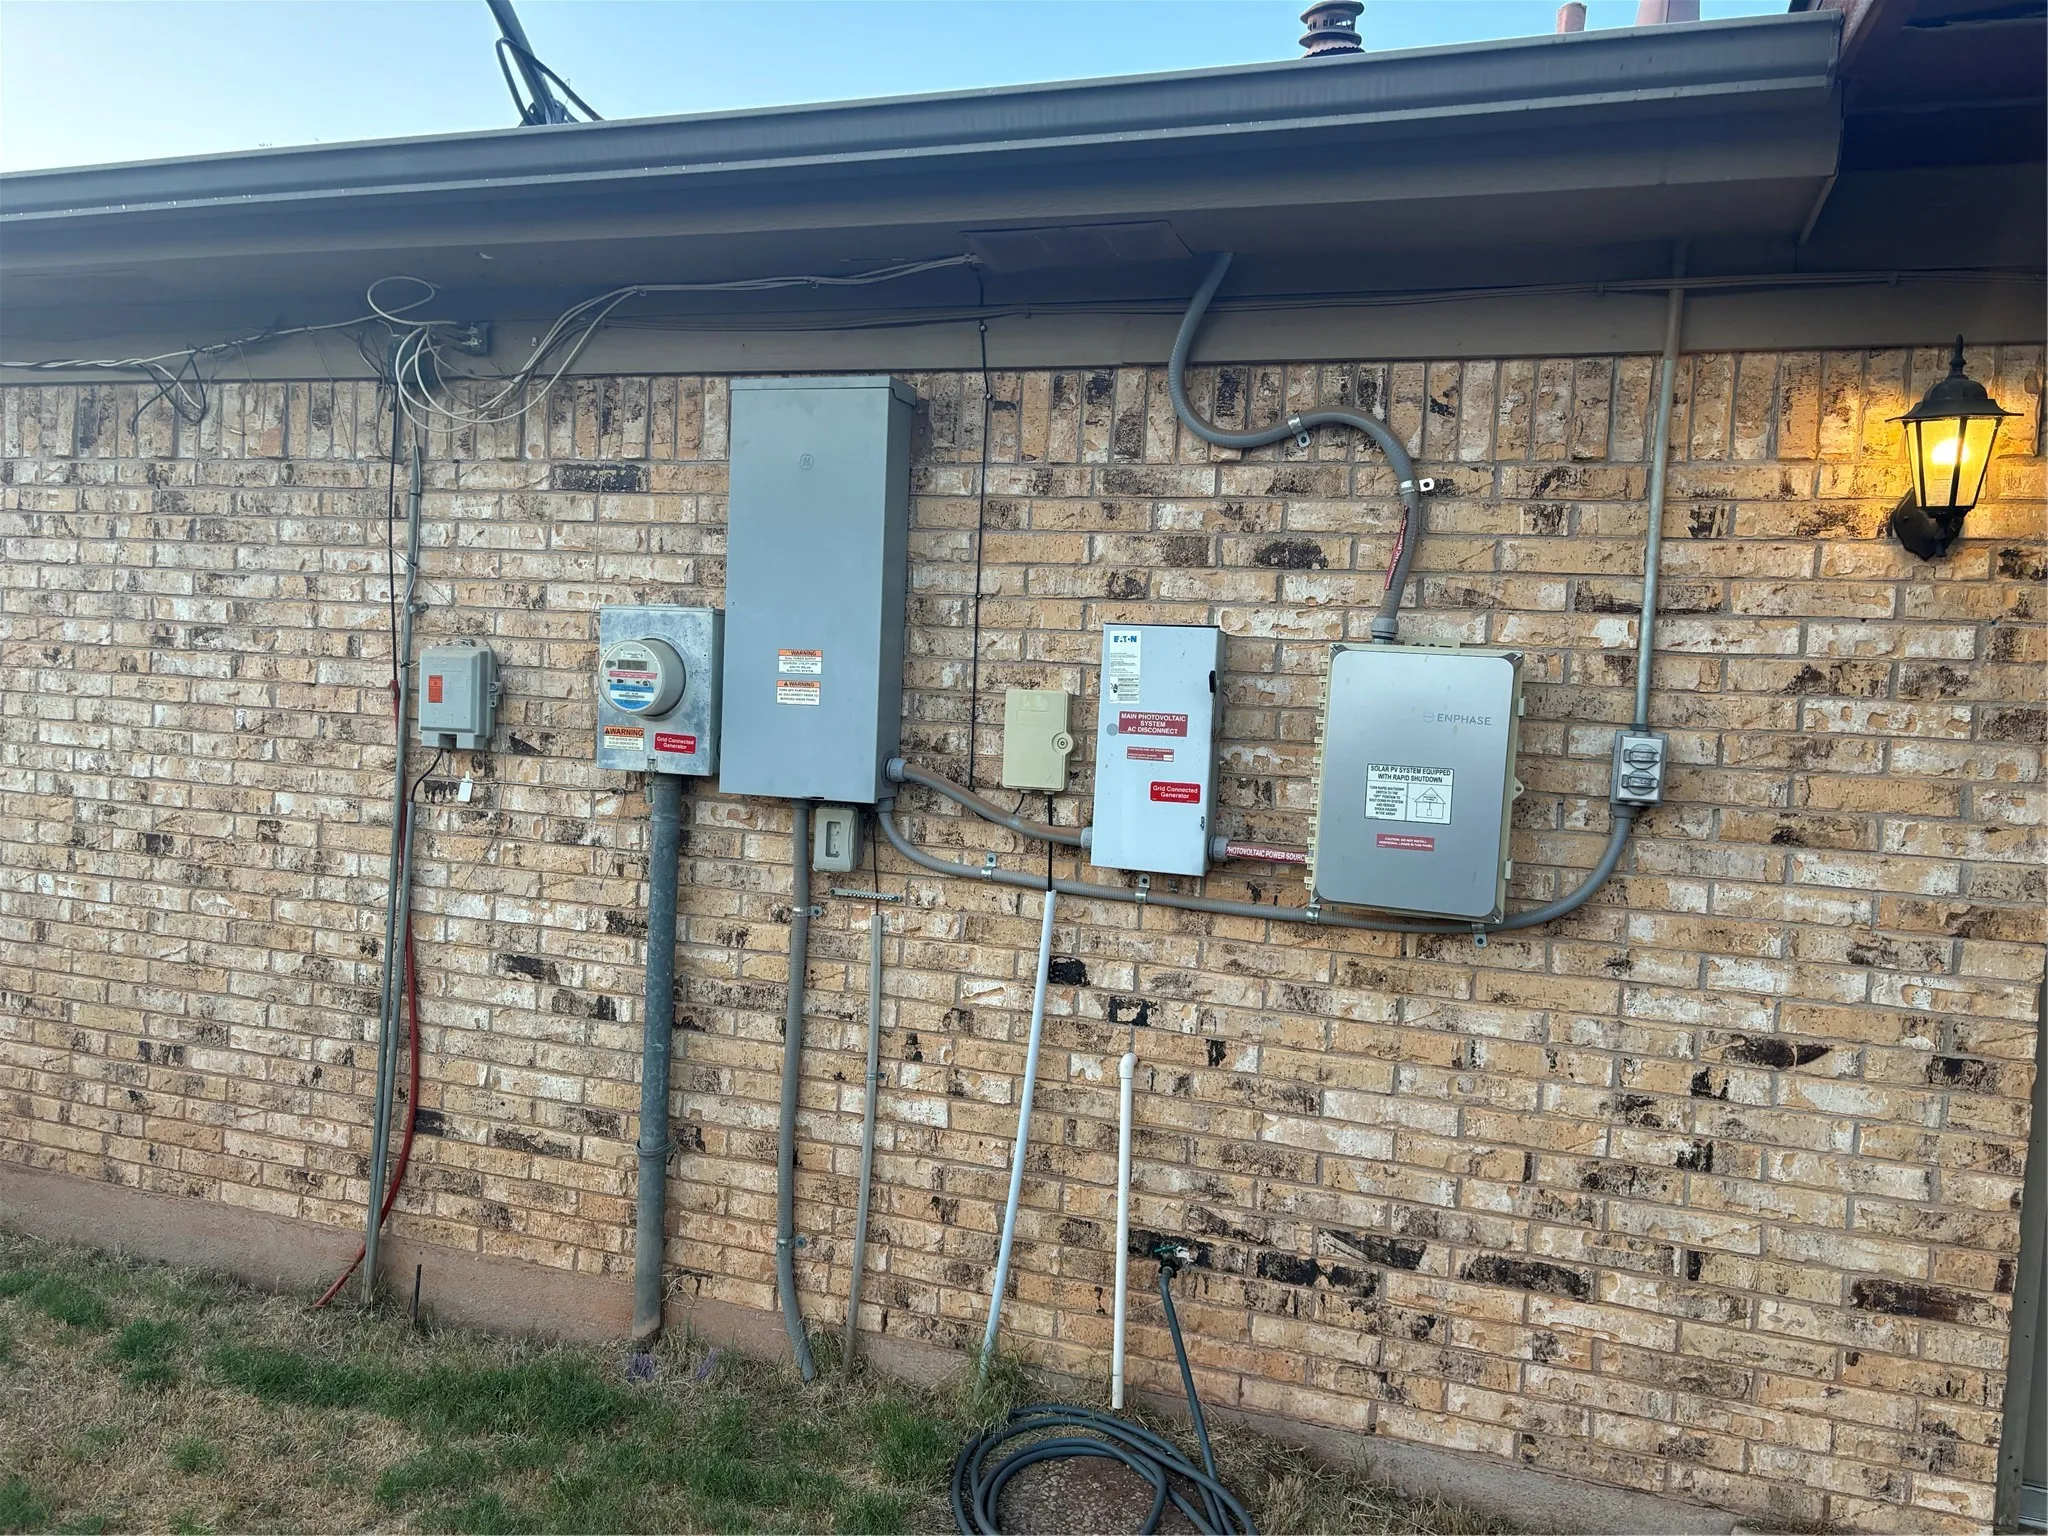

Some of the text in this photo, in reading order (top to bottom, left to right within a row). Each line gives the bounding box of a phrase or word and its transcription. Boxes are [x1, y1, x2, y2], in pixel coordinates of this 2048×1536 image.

[1138, 714, 1186, 722] PHOTOVOLTAIC
[1438, 713, 1492, 726] ENPHASE
[610, 728, 643, 736] WARNING
[1410, 775, 1442, 783] SHUTDOWN
[1265, 850, 1285, 860] POWER
